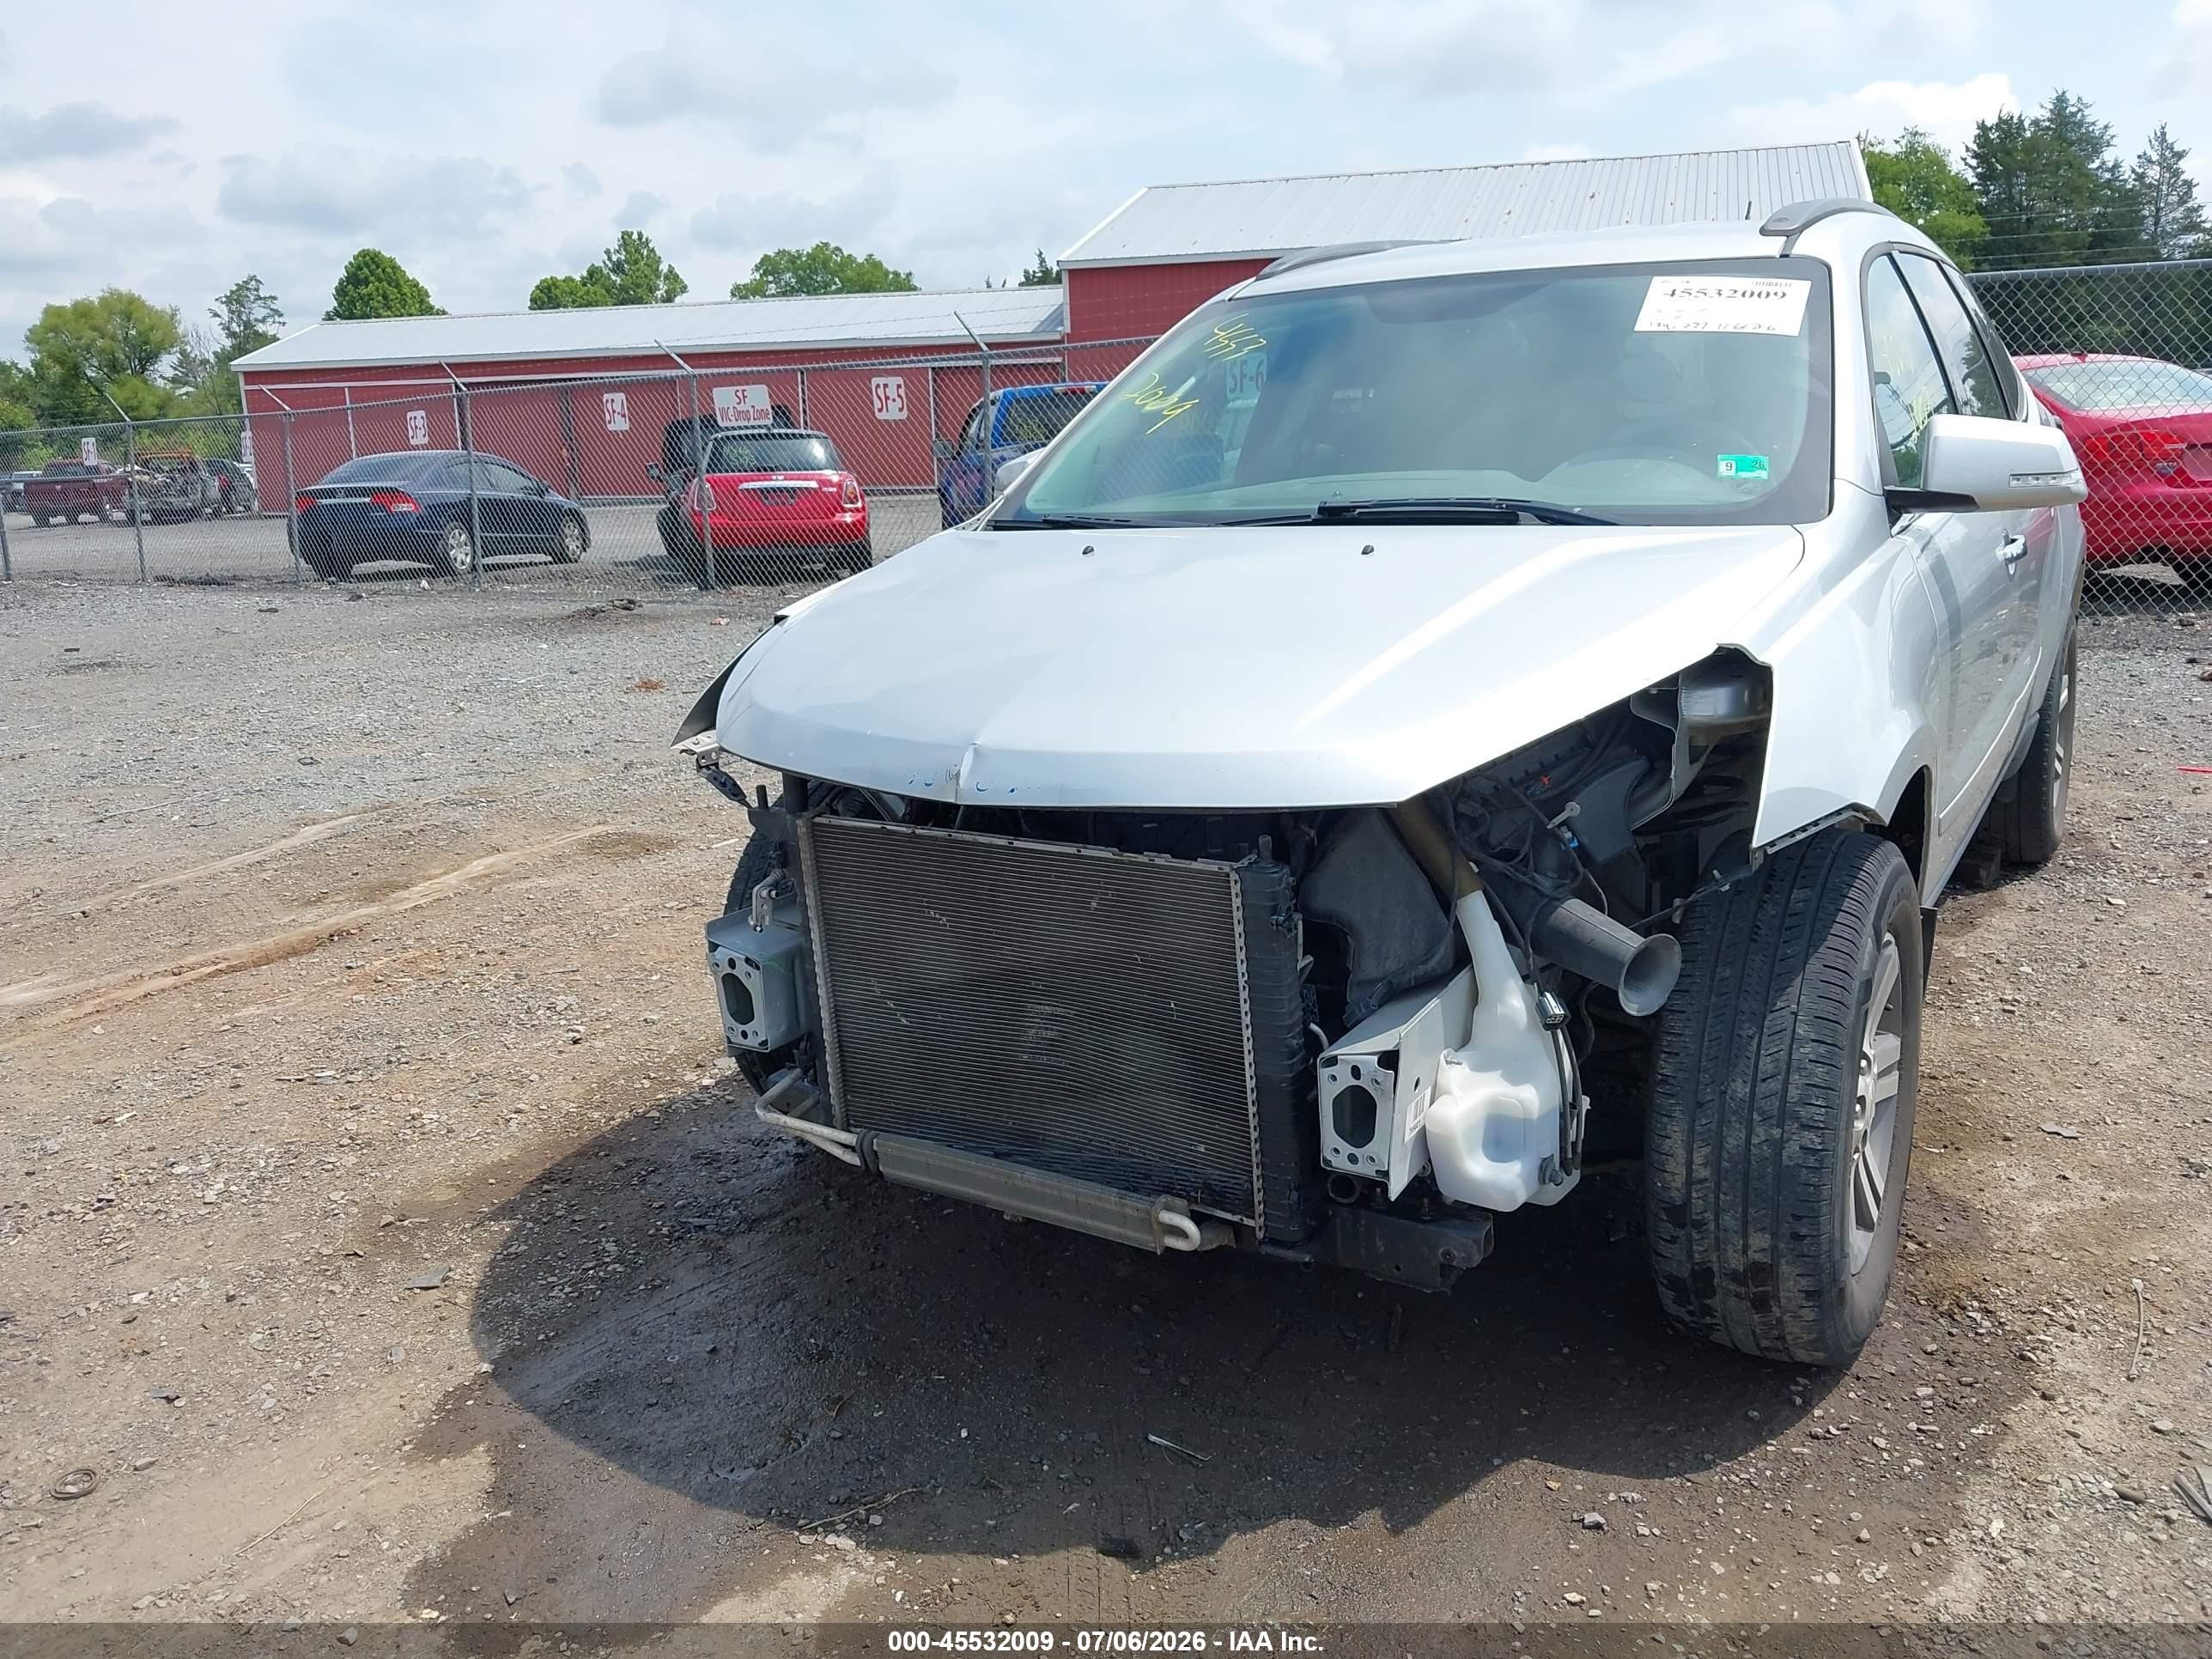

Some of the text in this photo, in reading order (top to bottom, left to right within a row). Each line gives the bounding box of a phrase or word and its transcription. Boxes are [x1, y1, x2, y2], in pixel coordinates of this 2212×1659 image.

[1662, 288, 1787, 299] 45532009
[1229, 357, 1264, 395] SF-6
[734, 389, 748, 404] SF
[874, 383, 905, 413] SF-5
[605, 398, 627, 424] SF-4
[718, 404, 770, 423] VIC-Drop Zone
[409, 416, 426, 440] SF-3
[82, 441, 97, 461] SF-1
[1725, 461, 1733, 471] 9
